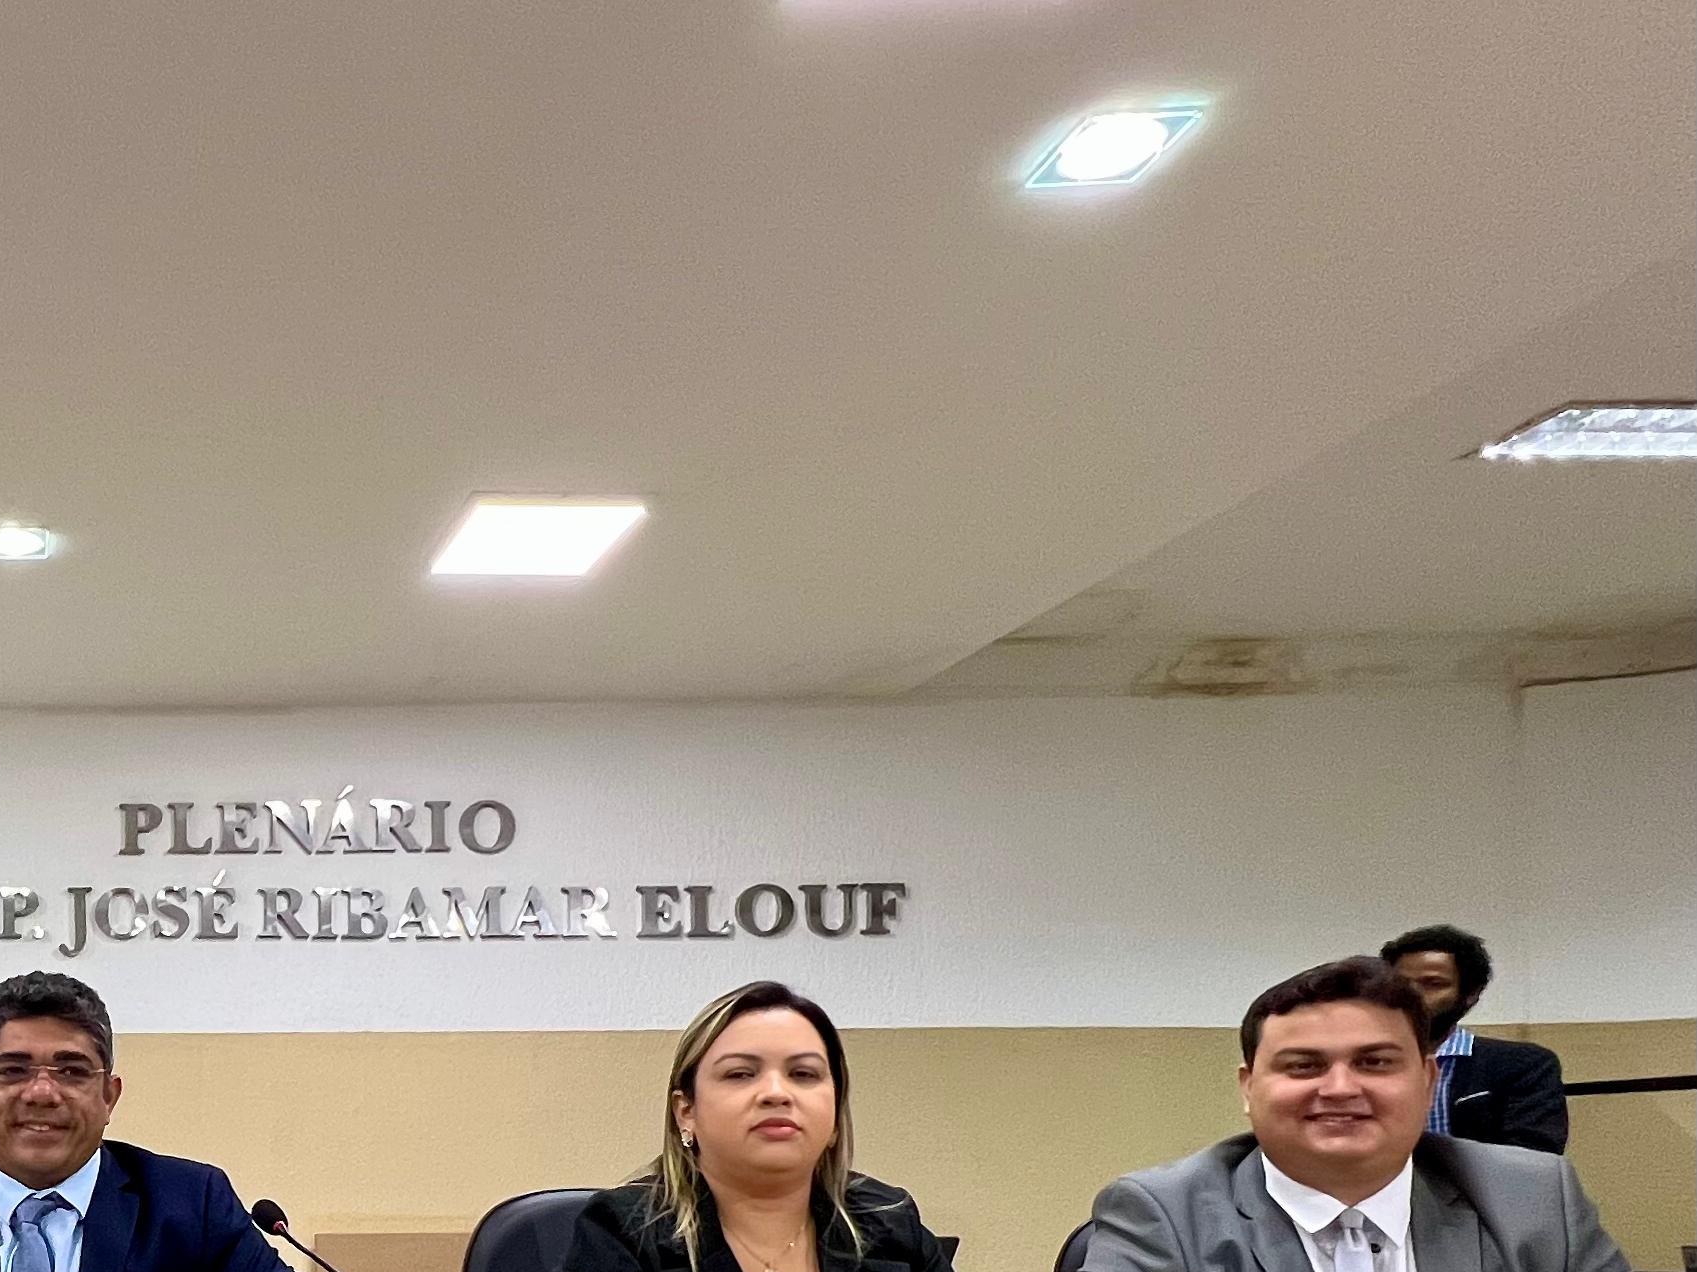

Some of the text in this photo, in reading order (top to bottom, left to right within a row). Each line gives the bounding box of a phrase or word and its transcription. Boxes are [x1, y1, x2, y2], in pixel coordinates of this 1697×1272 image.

[117, 785, 516, 854] PLENÁRIO
[58, 869, 239, 957] JOSÉ
[256, 886, 617, 939] RIBAMAR
[636, 883, 906, 938] ELOUF
